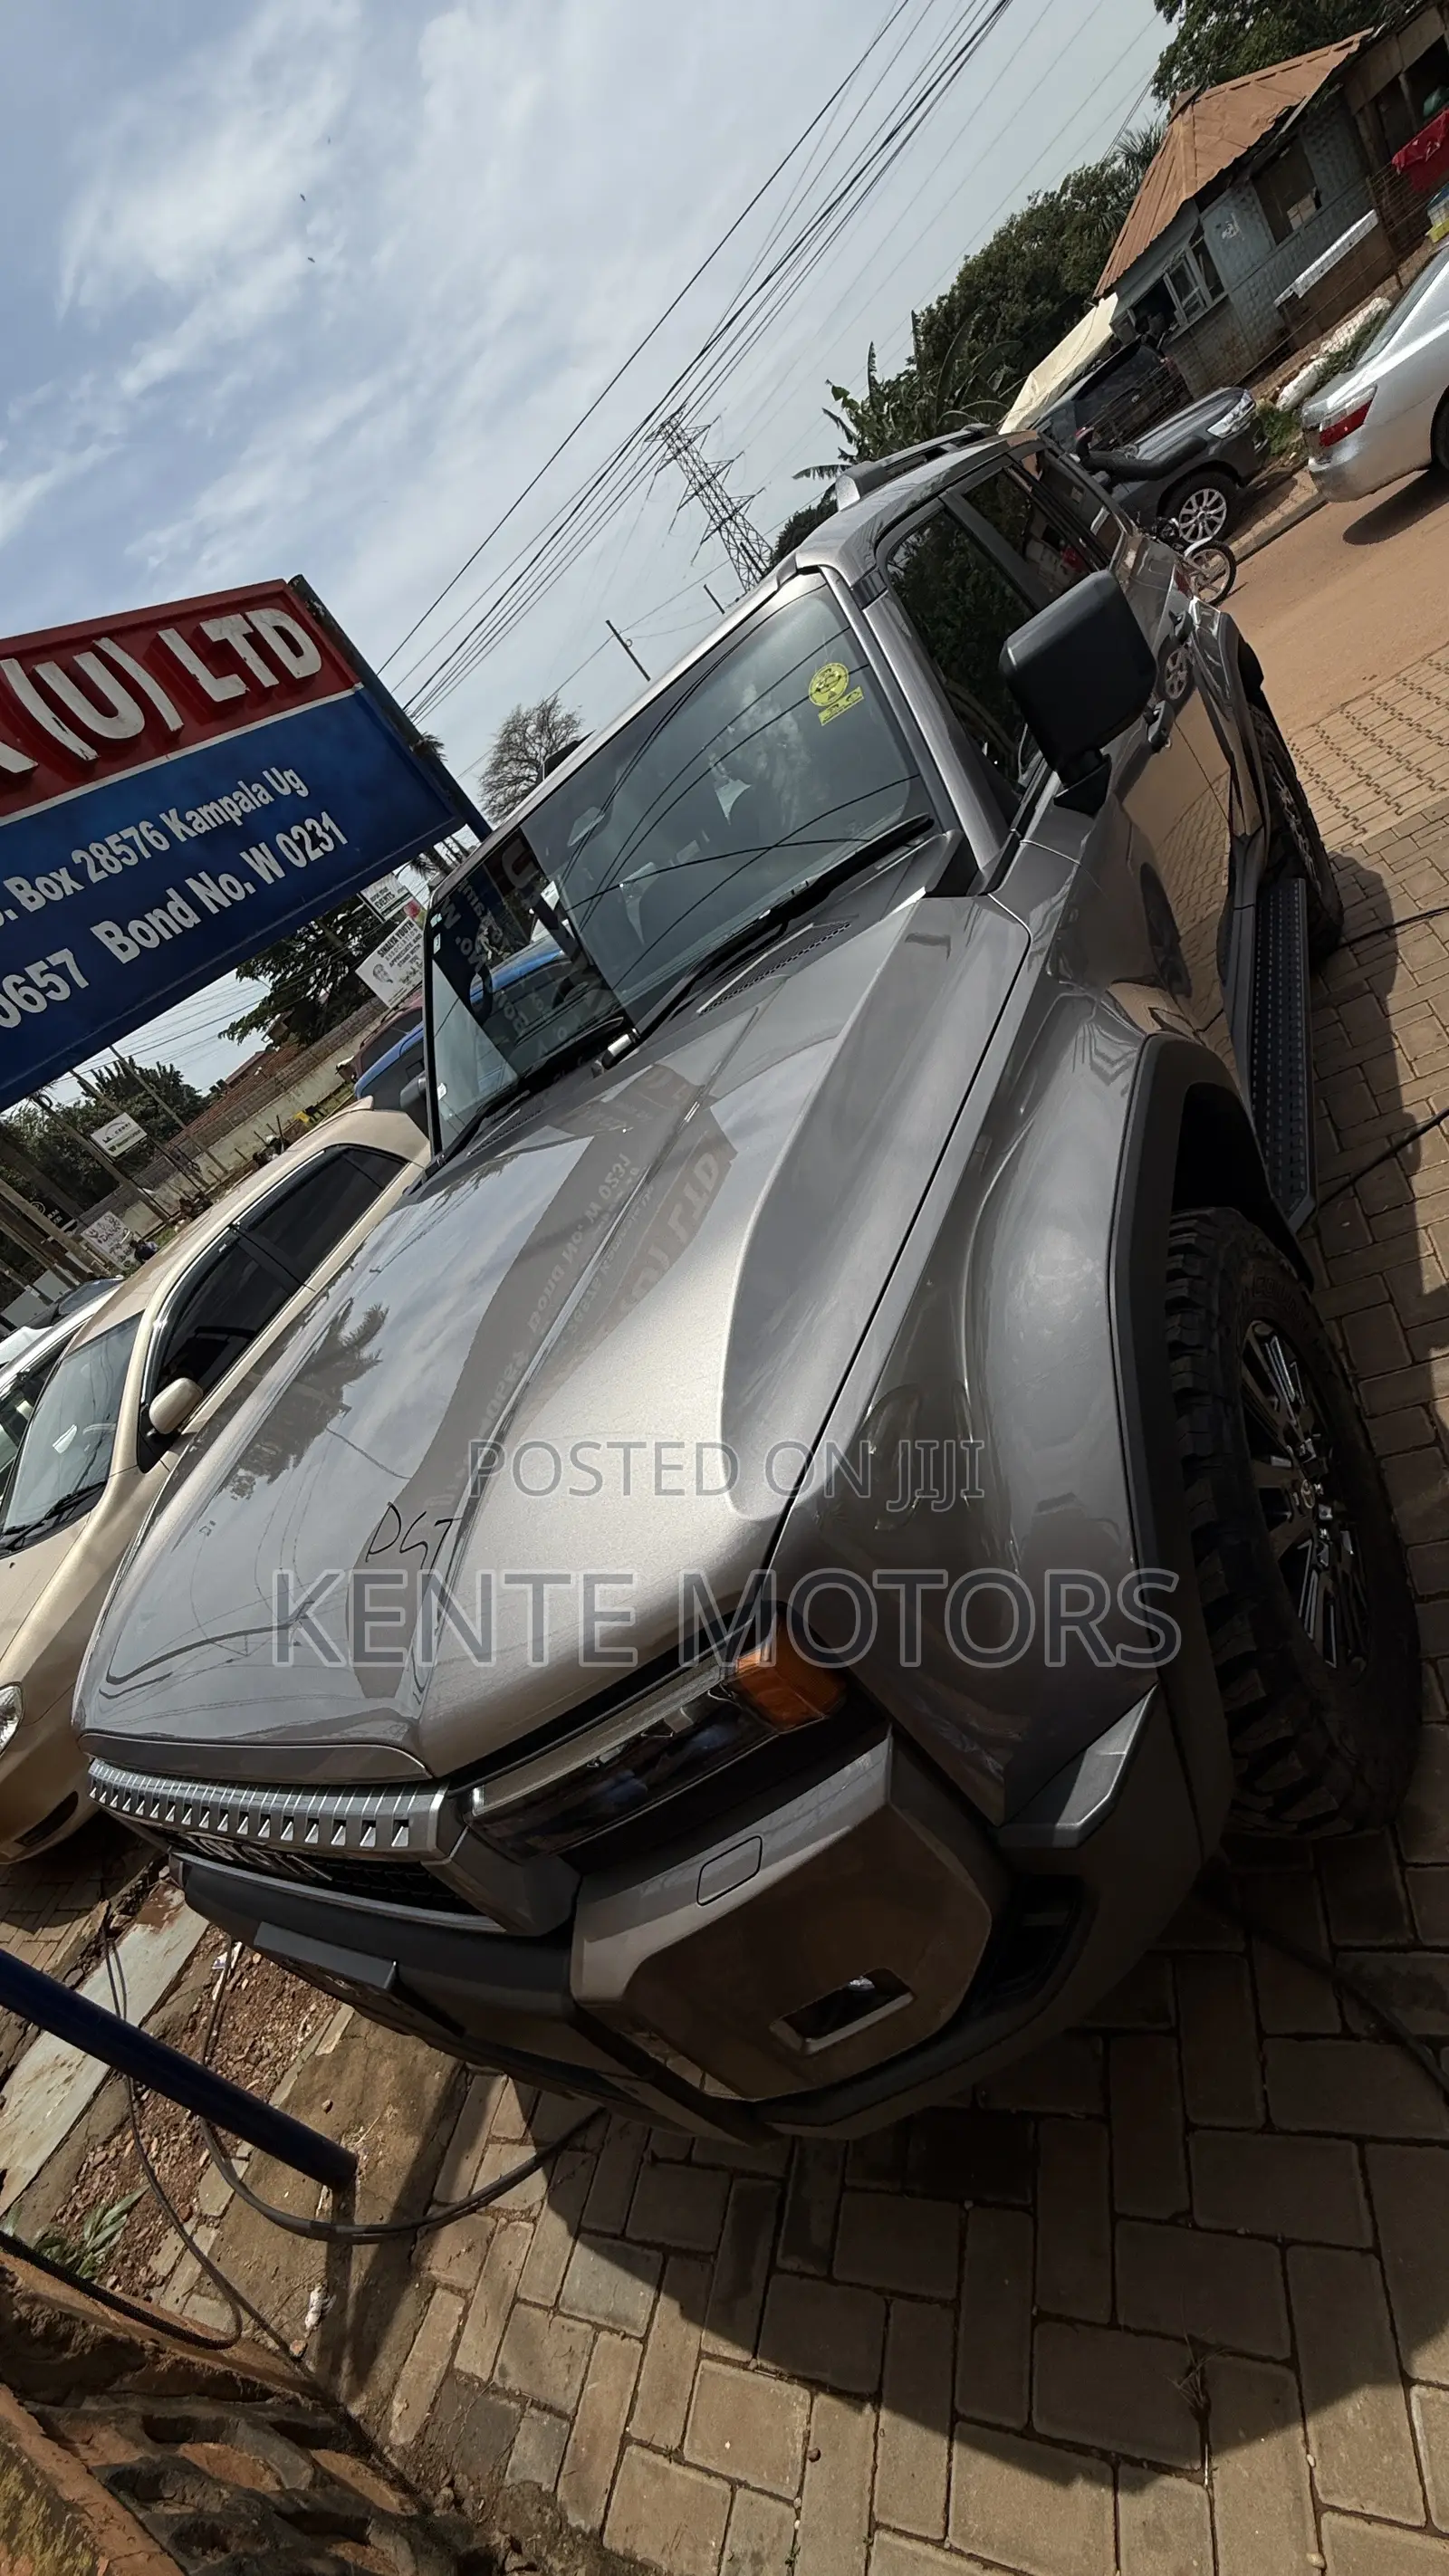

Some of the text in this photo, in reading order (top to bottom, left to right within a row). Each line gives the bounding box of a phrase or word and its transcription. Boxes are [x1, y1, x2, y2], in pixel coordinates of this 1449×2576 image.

[1, 608, 322, 761] (U) LTD
[3, 767, 310, 913] Box 28576 Kampala Ug
[90, 887, 202, 964] Bond
[184, 870, 256, 915] No.
[239, 841, 285, 885] W
[275, 810, 349, 868] 0231
[395, 920, 414, 939] YOUTH
